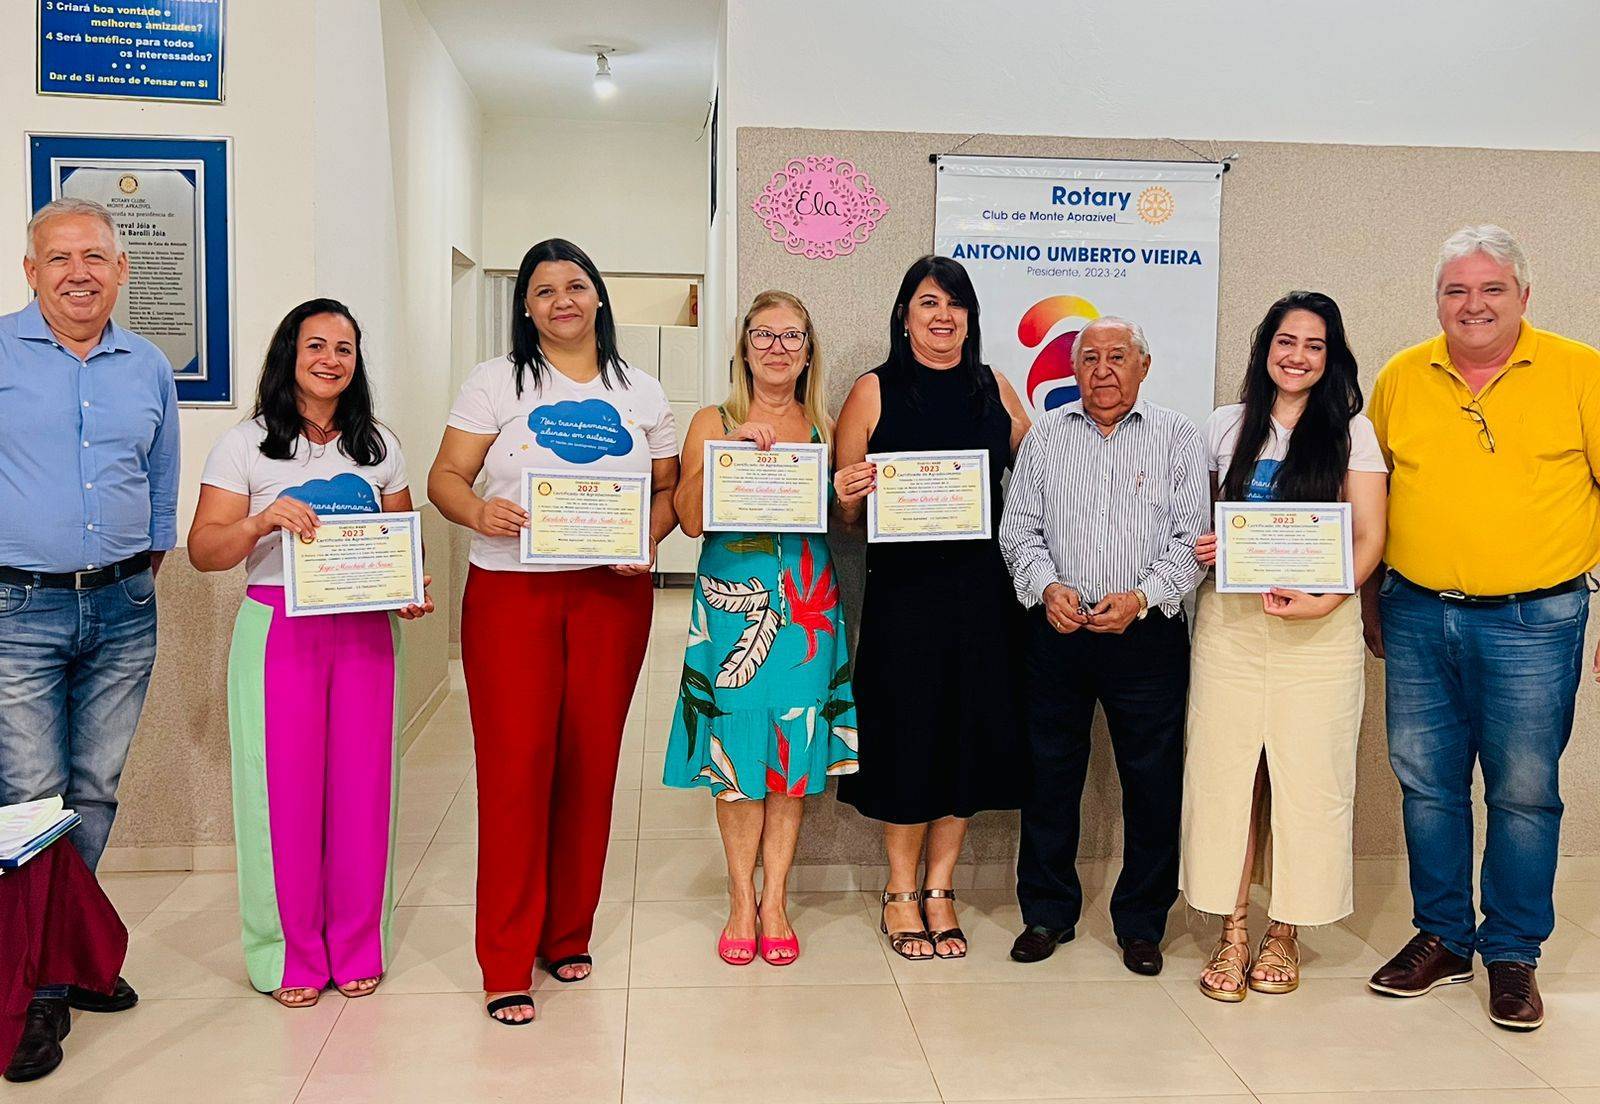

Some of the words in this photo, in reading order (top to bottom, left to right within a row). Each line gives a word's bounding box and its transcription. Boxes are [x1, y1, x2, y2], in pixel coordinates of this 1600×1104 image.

[46, 2, 54, 10] 3
[56, 2, 91, 13] Criará
[93, 4, 114, 14] boa
[117, 6, 161, 16] vontade
[90, 18, 142, 29] melhores
[145, 21, 203, 32] amizades?
[46, 32, 53, 41] 4
[55, 32, 82, 42] Será
[85, 34, 133, 45] benéfico
[135, 38, 161, 47] para
[164, 38, 194, 48] todos
[119, 50, 133, 58] os
[136, 50, 213, 62] interessados?
[49, 72, 67, 81] Dar
[69, 73, 82, 82] de
[85, 73, 95, 82] Si
[97, 75, 126, 84] antes
[128, 75, 141, 84] de
[143, 77, 177, 86] Pensar
[180, 79, 195, 87] em
[198, 79, 208, 88] Si
[795, 190, 841, 216] Ela
[1051, 186, 1131, 211] Rotary
[982, 210, 1008, 220] Club
[1012, 210, 1026, 221] de
[1029, 211, 1064, 222] Monte
[952, 243, 1040, 261] ANTONIO
[1047, 246, 1136, 265] UMBERTO
[1141, 248, 1202, 266] VIEIRA
[1026, 266, 1081, 279] Presidente,
[1084, 267, 1127, 279] 2023-24
[757, 456, 777, 464] 2023
[920, 465, 940, 473] 2023
[577, 485, 599, 493] 2023
[342, 529, 365, 538] 2023
